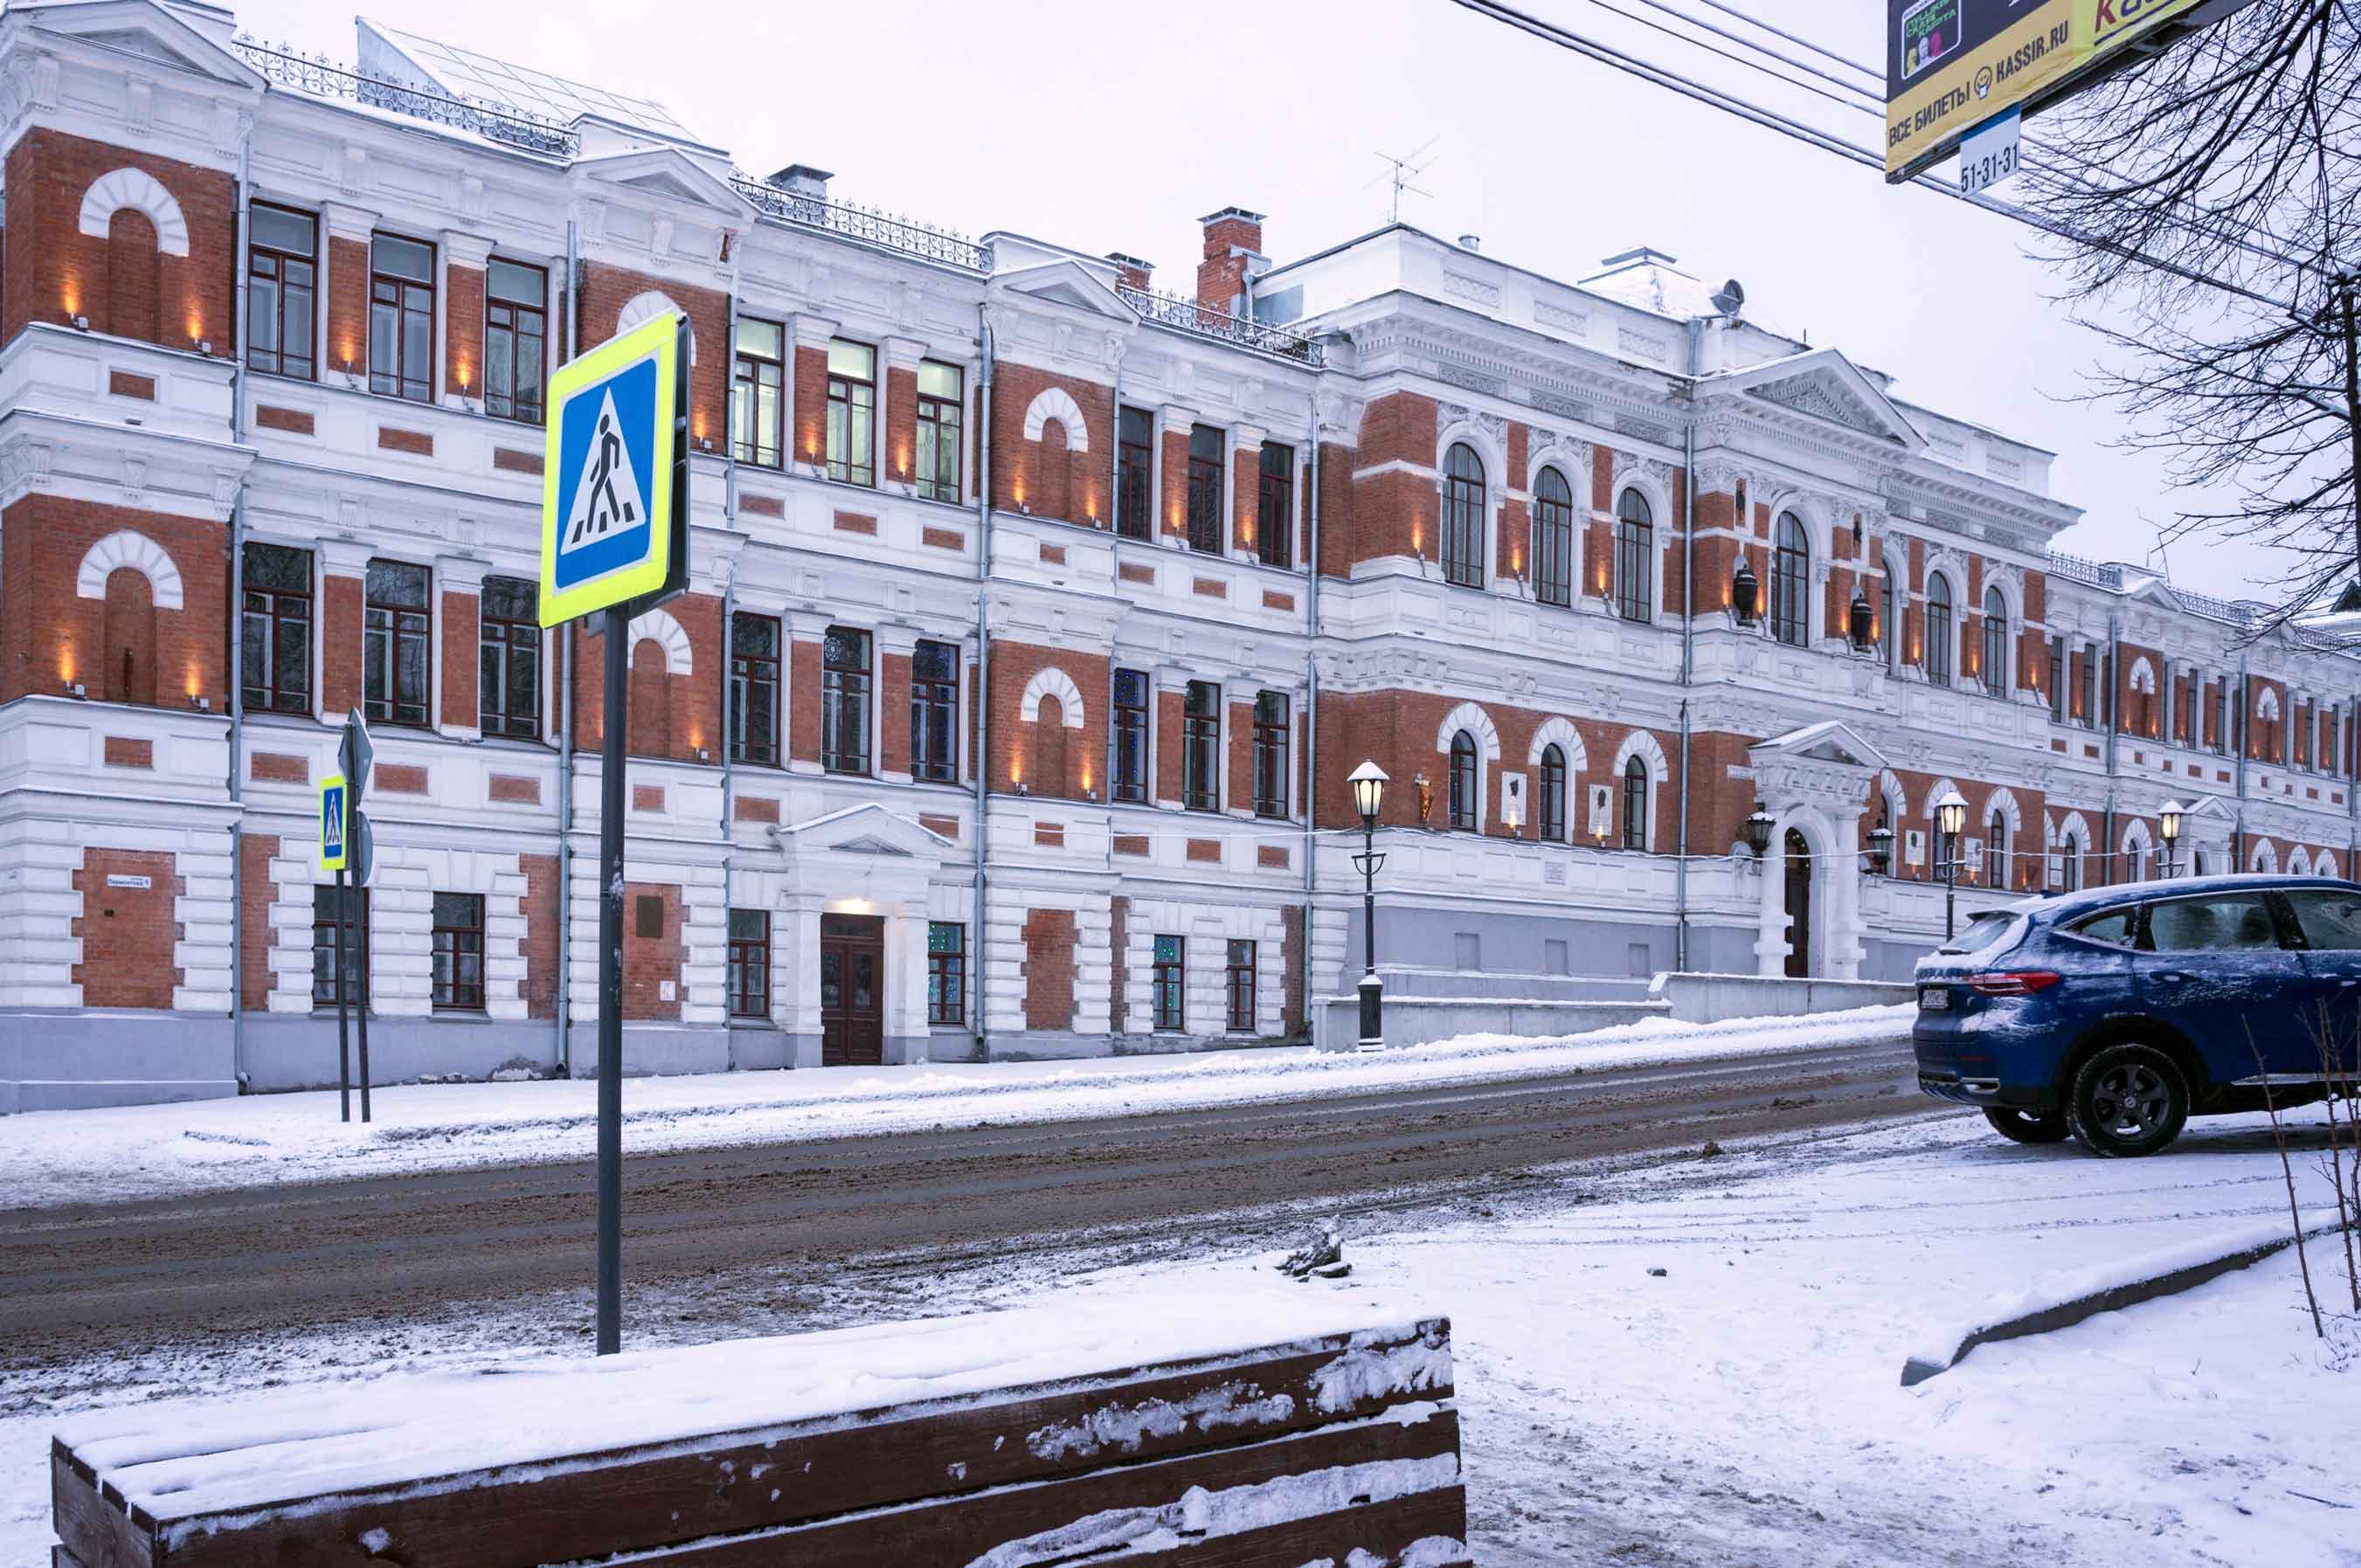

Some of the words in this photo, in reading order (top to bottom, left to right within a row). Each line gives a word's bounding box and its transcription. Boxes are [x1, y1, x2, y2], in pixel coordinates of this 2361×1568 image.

[1888, 117, 1912, 147] ВСЕ
[1914, 81, 1970, 132] БИЛЕТЫ
[1996, 20, 2069, 83] KASSIR.RU
[1961, 142, 2018, 192] 51-31-31
